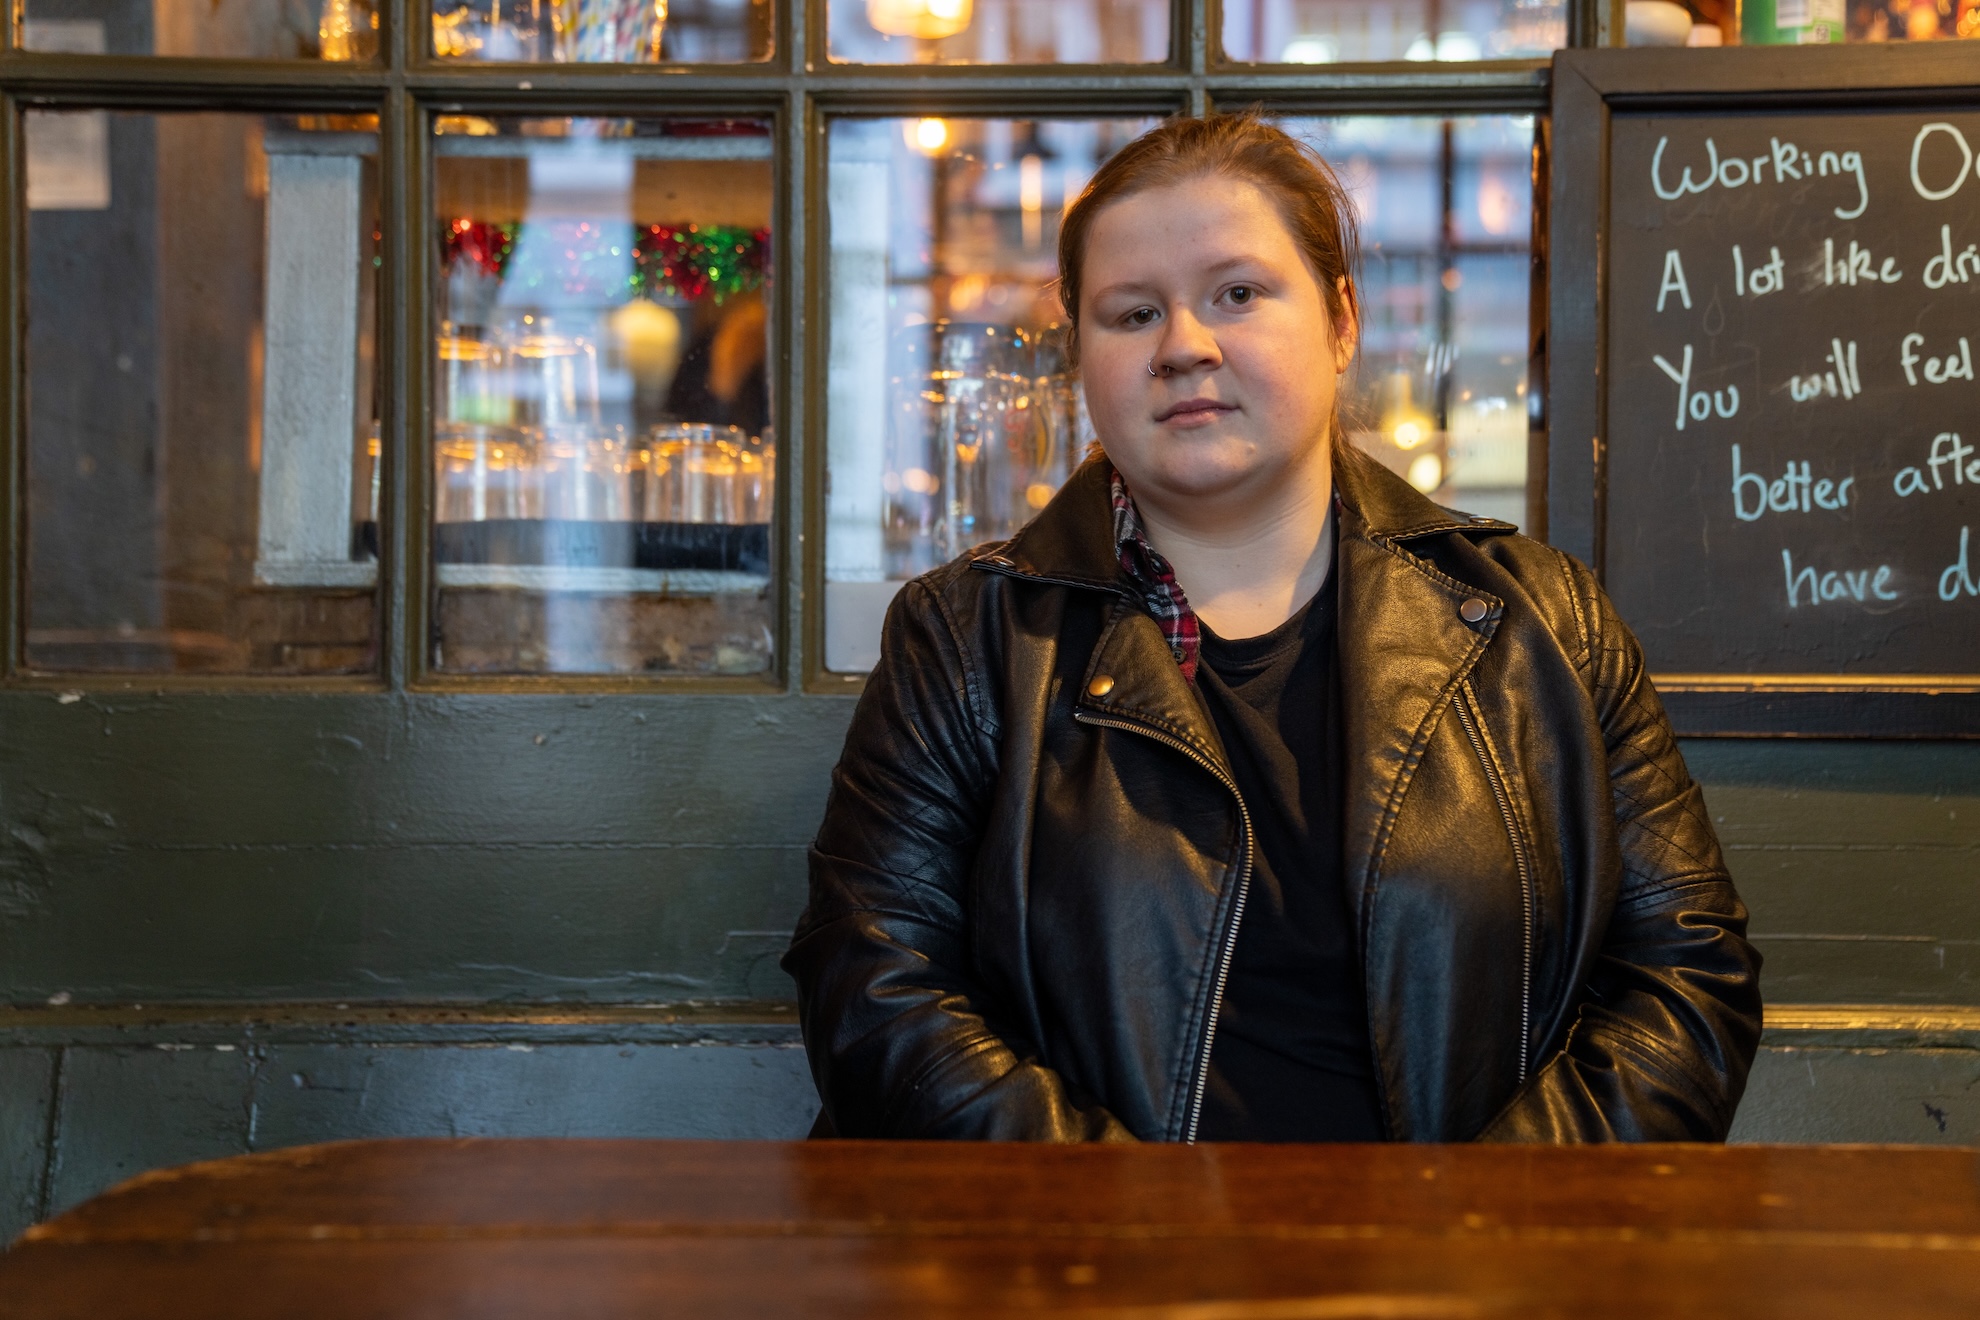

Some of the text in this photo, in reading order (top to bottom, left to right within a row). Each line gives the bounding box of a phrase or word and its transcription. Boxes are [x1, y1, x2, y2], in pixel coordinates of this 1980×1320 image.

[1651, 136, 1869, 220] Working
[1910, 122, 1980, 200] O
[1656, 249, 1692, 313] A
[1733, 245, 1785, 296] lot
[1824, 237, 1902, 287] like
[1652, 332, 1975, 431] You will feel
[1732, 444, 1855, 522] better
[1782, 525, 1980, 608] have d
